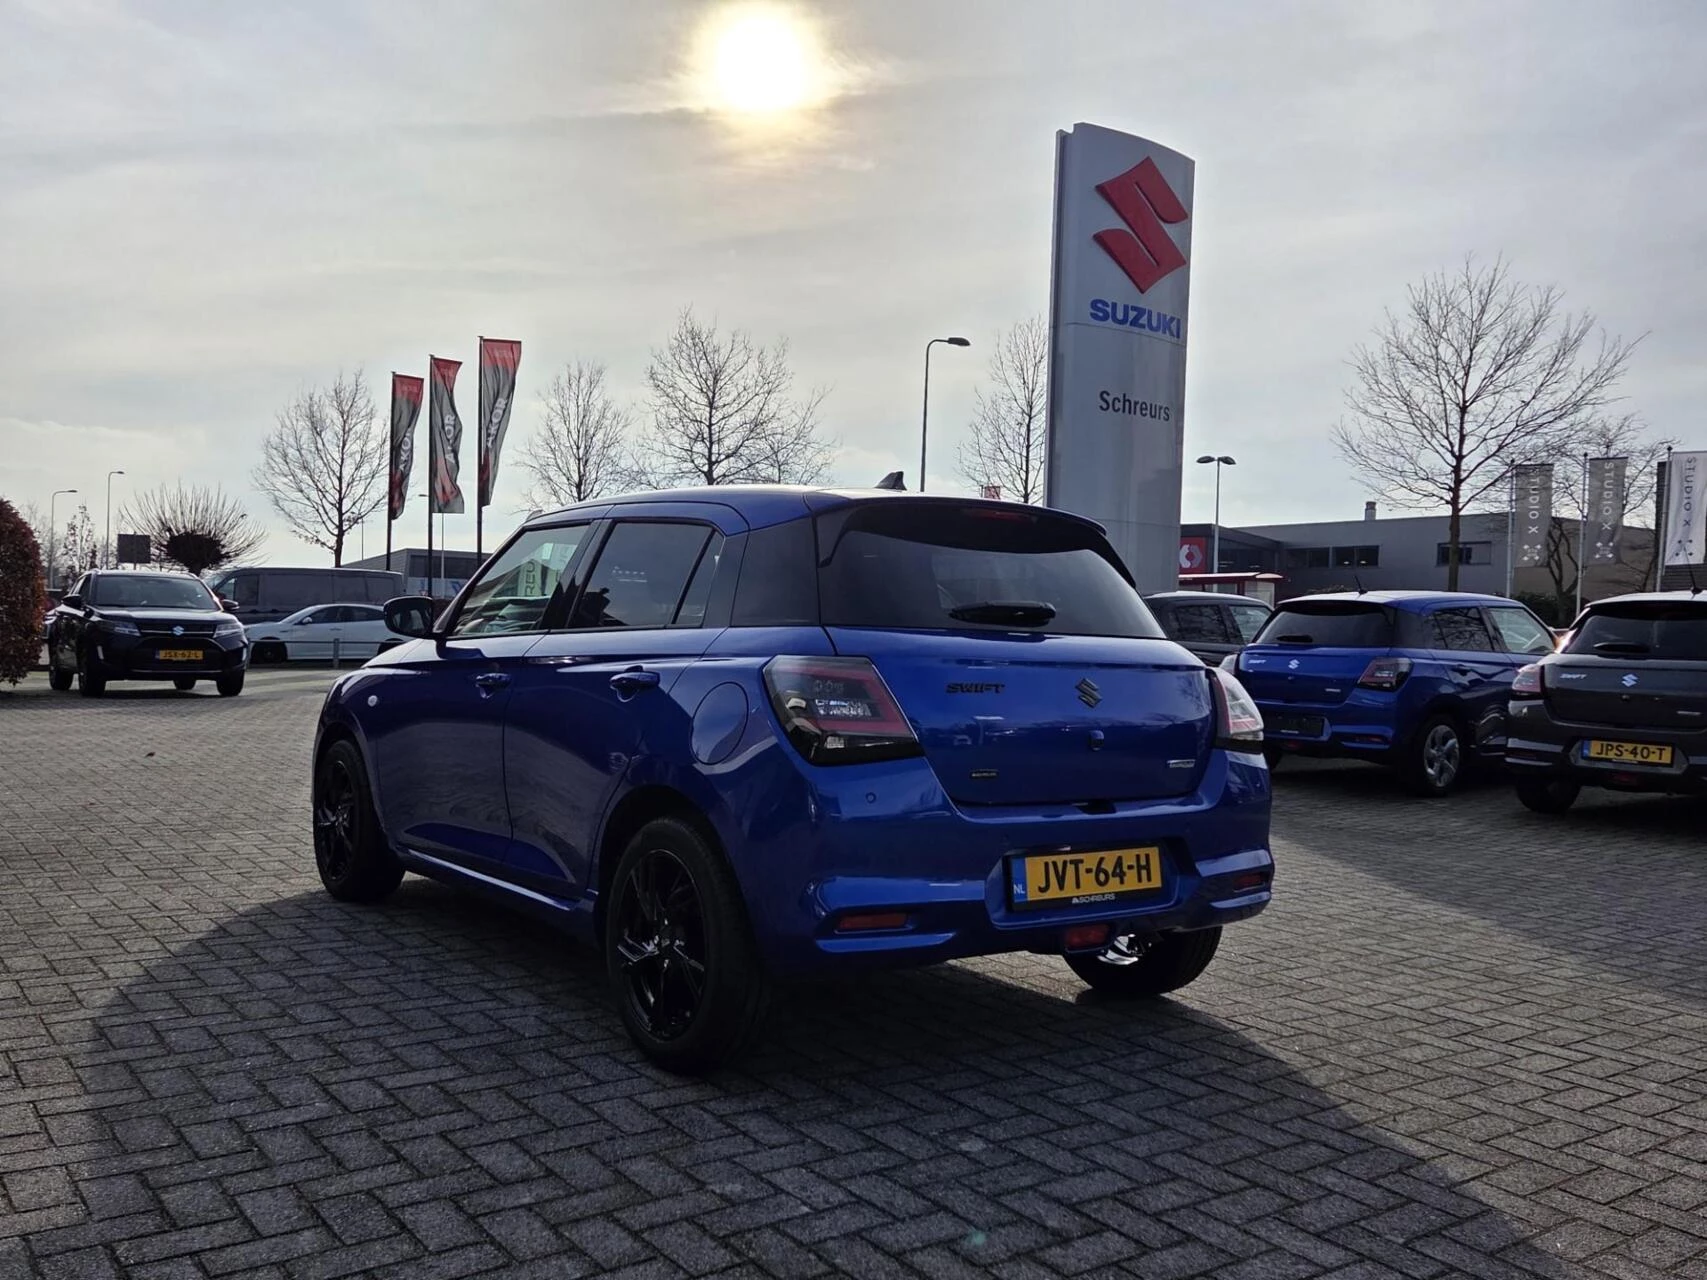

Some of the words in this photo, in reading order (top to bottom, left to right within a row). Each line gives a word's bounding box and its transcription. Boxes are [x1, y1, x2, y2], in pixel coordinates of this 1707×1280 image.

[1090, 298, 1181, 339] SUZUKI
[1099, 390, 1170, 421] Schreurs
[1602, 461, 1615, 516] STUDIO
[1683, 456, 1697, 512] STUDIO
[1528, 525, 1539, 534] X
[1601, 521, 1613, 531] X
[946, 683, 1005, 694] SWIFT
[1596, 743, 1666, 761] JPS-40-T
[1013, 883, 1026, 895] NL
[1038, 853, 1153, 894] JVT-64-H
